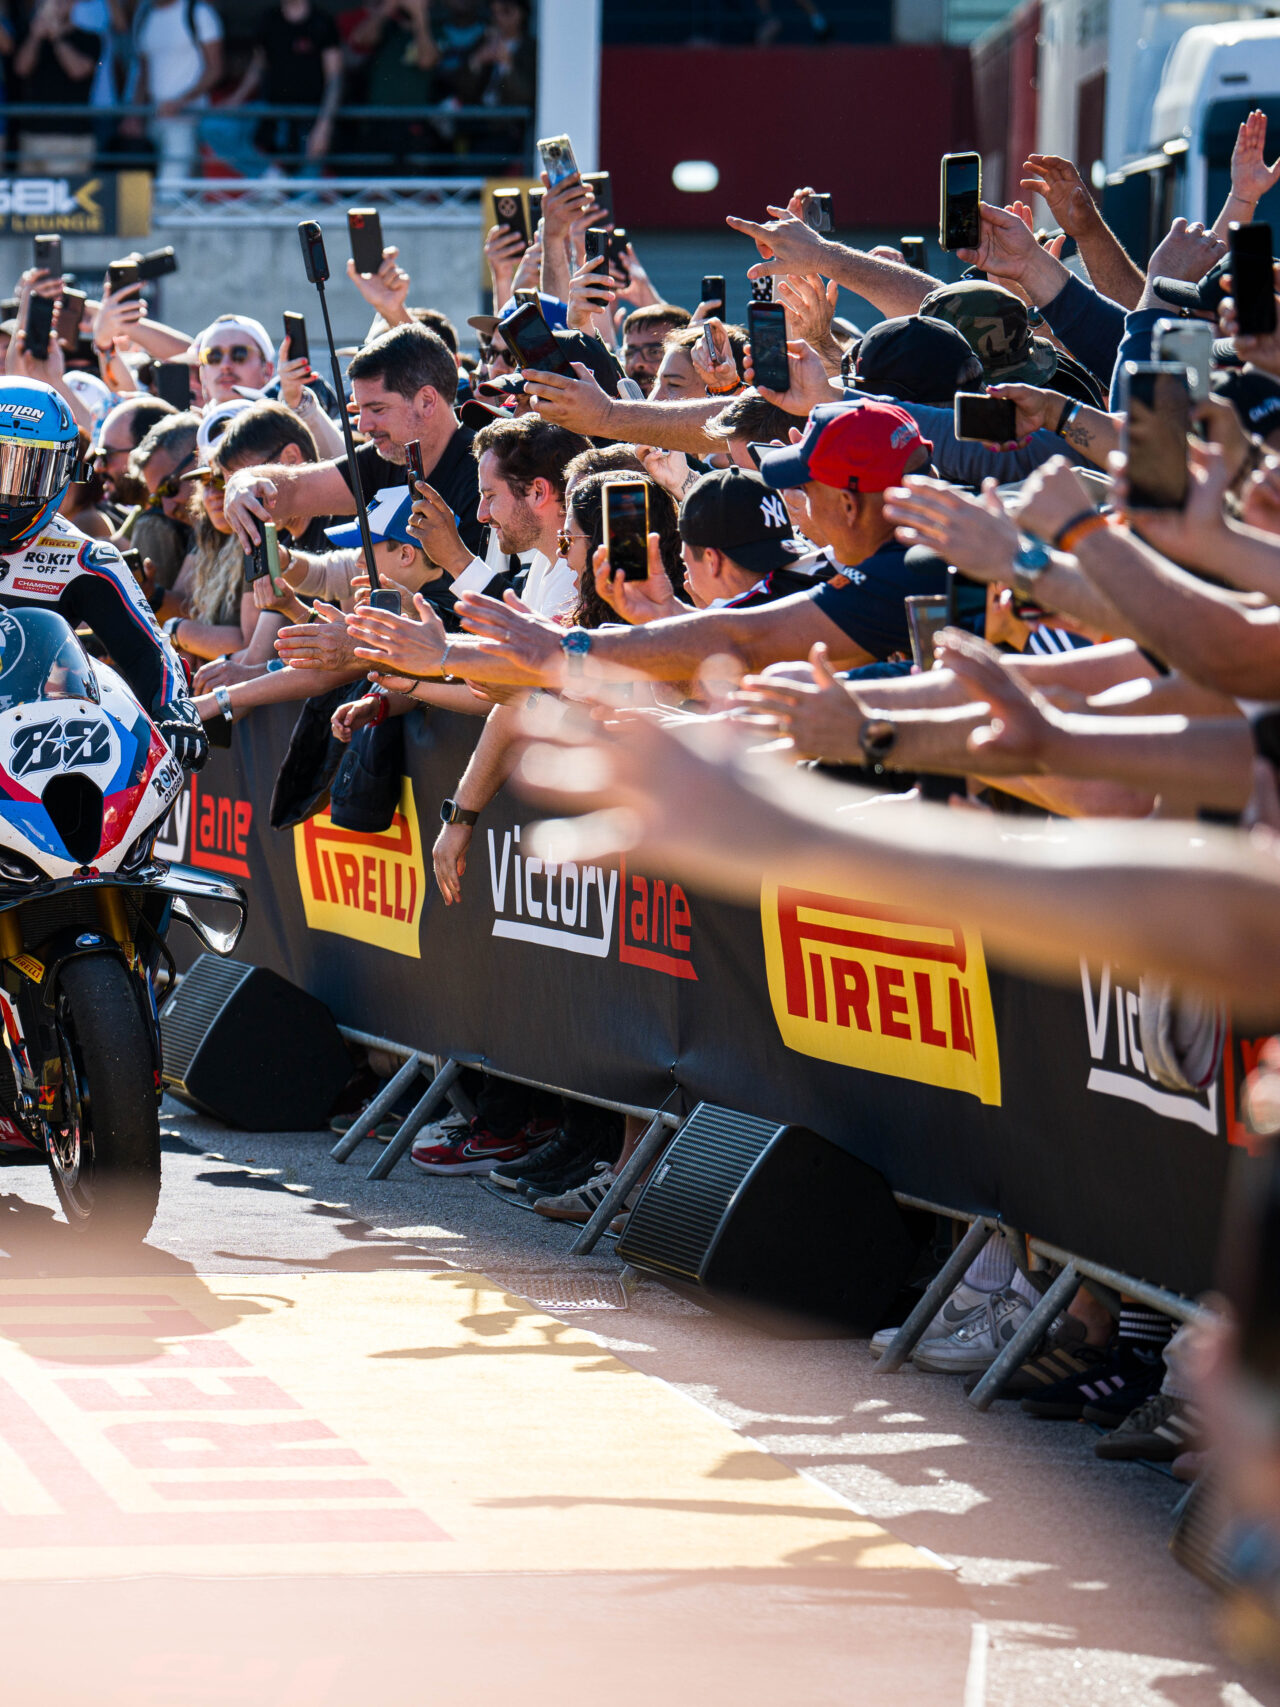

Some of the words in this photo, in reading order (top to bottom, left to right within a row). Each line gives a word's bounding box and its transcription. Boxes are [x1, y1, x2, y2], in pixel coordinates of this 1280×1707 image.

[11, 213, 102, 232] LOUNGE
[760, 495, 788, 528] NY
[39, 538, 78, 549] PIRELLI
[17, 580, 61, 591] CHAMPION
[36, 565, 58, 574] OFF
[10, 716, 112, 779] 88
[190, 772, 253, 880] Lane
[303, 803, 417, 925] PIRELLI
[487, 824, 618, 959] Victory
[12, 955, 43, 979] PIRELLI
[778, 884, 977, 1062] PIRELLI
